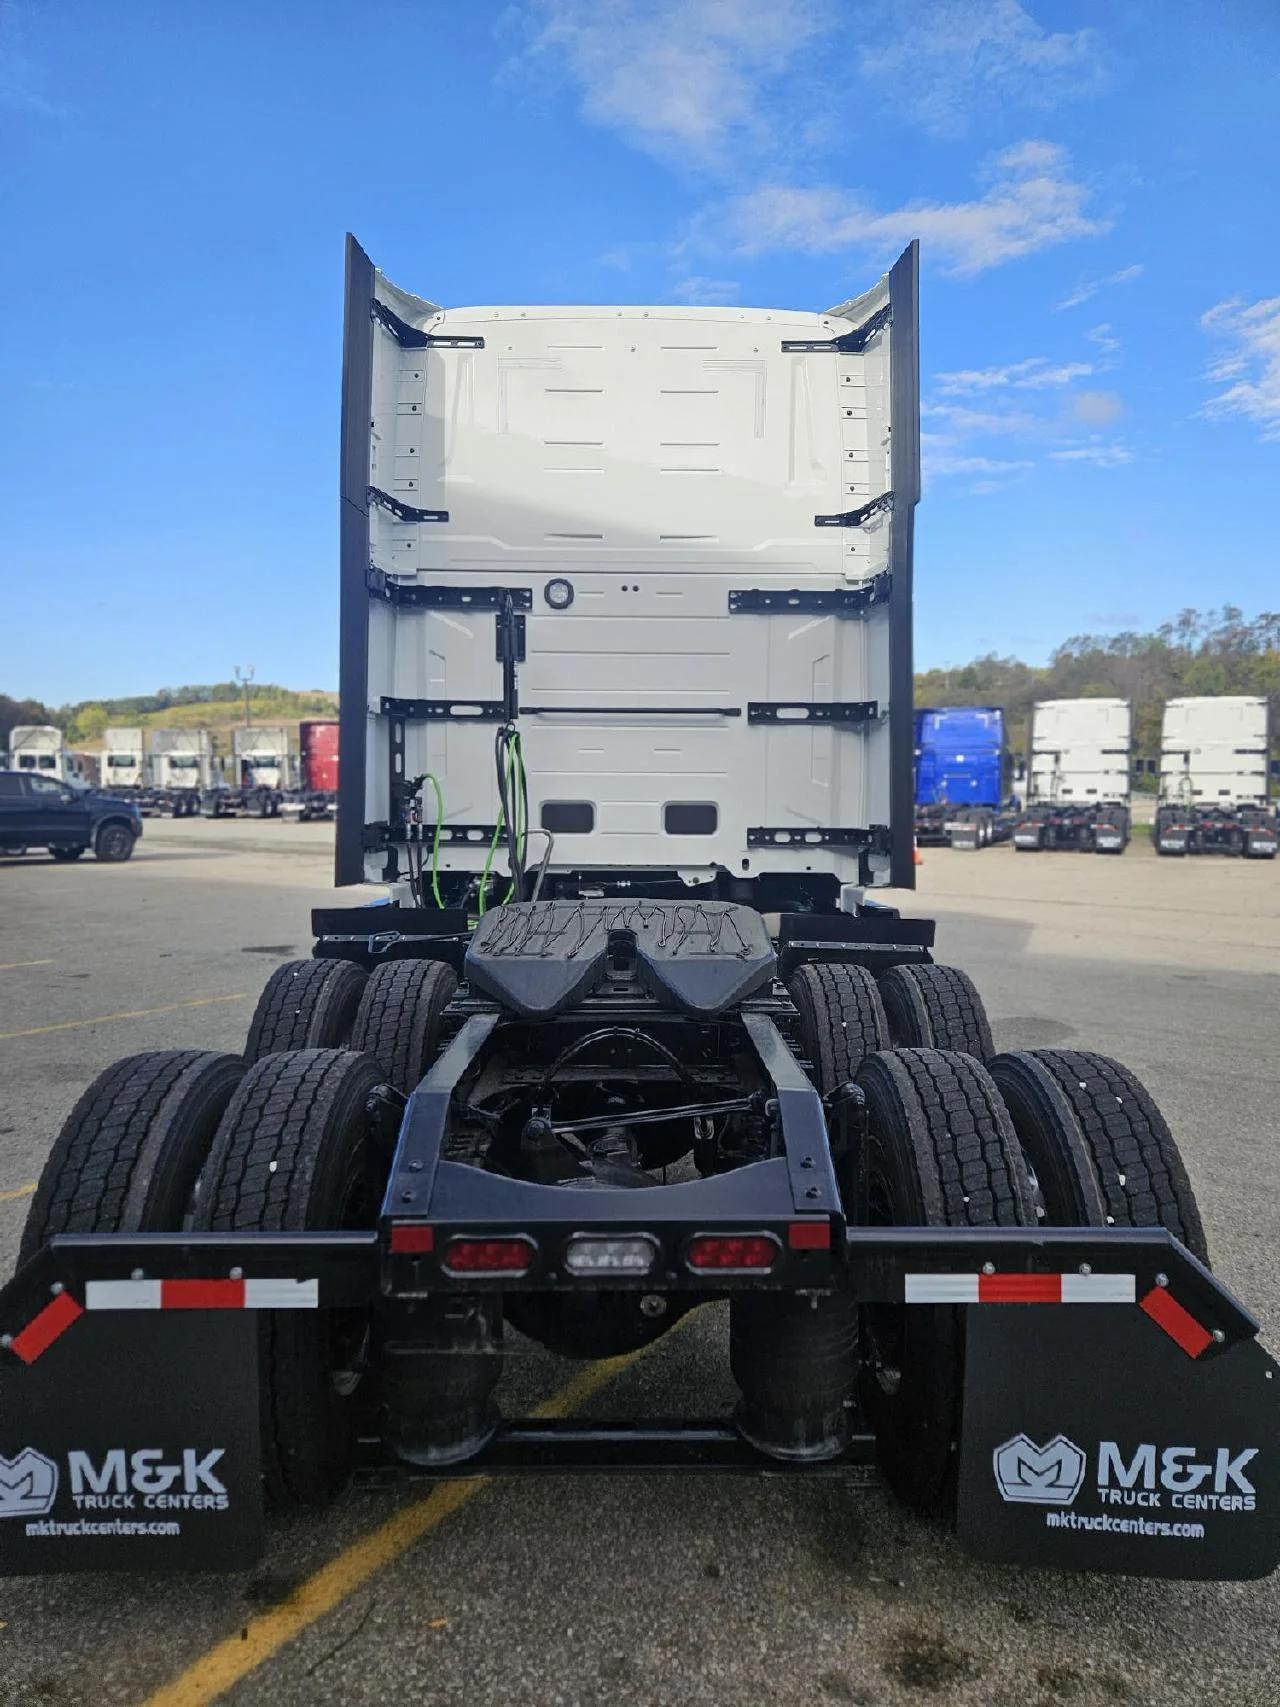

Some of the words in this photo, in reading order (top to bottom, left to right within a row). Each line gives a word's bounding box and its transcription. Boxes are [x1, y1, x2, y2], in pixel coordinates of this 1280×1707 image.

[68, 1448, 228, 1494] M&K
[1097, 1441, 1259, 1494] M&K
[72, 1494, 135, 1509] TRUCK
[144, 1494, 230, 1511] CENTERS
[1098, 1488, 1161, 1508] TRUCK
[1171, 1493, 1256, 1511] CENTERS
[26, 1519, 181, 1537] mktruckcenters.com
[1046, 1511, 1205, 1538] mktruckcenters.com
